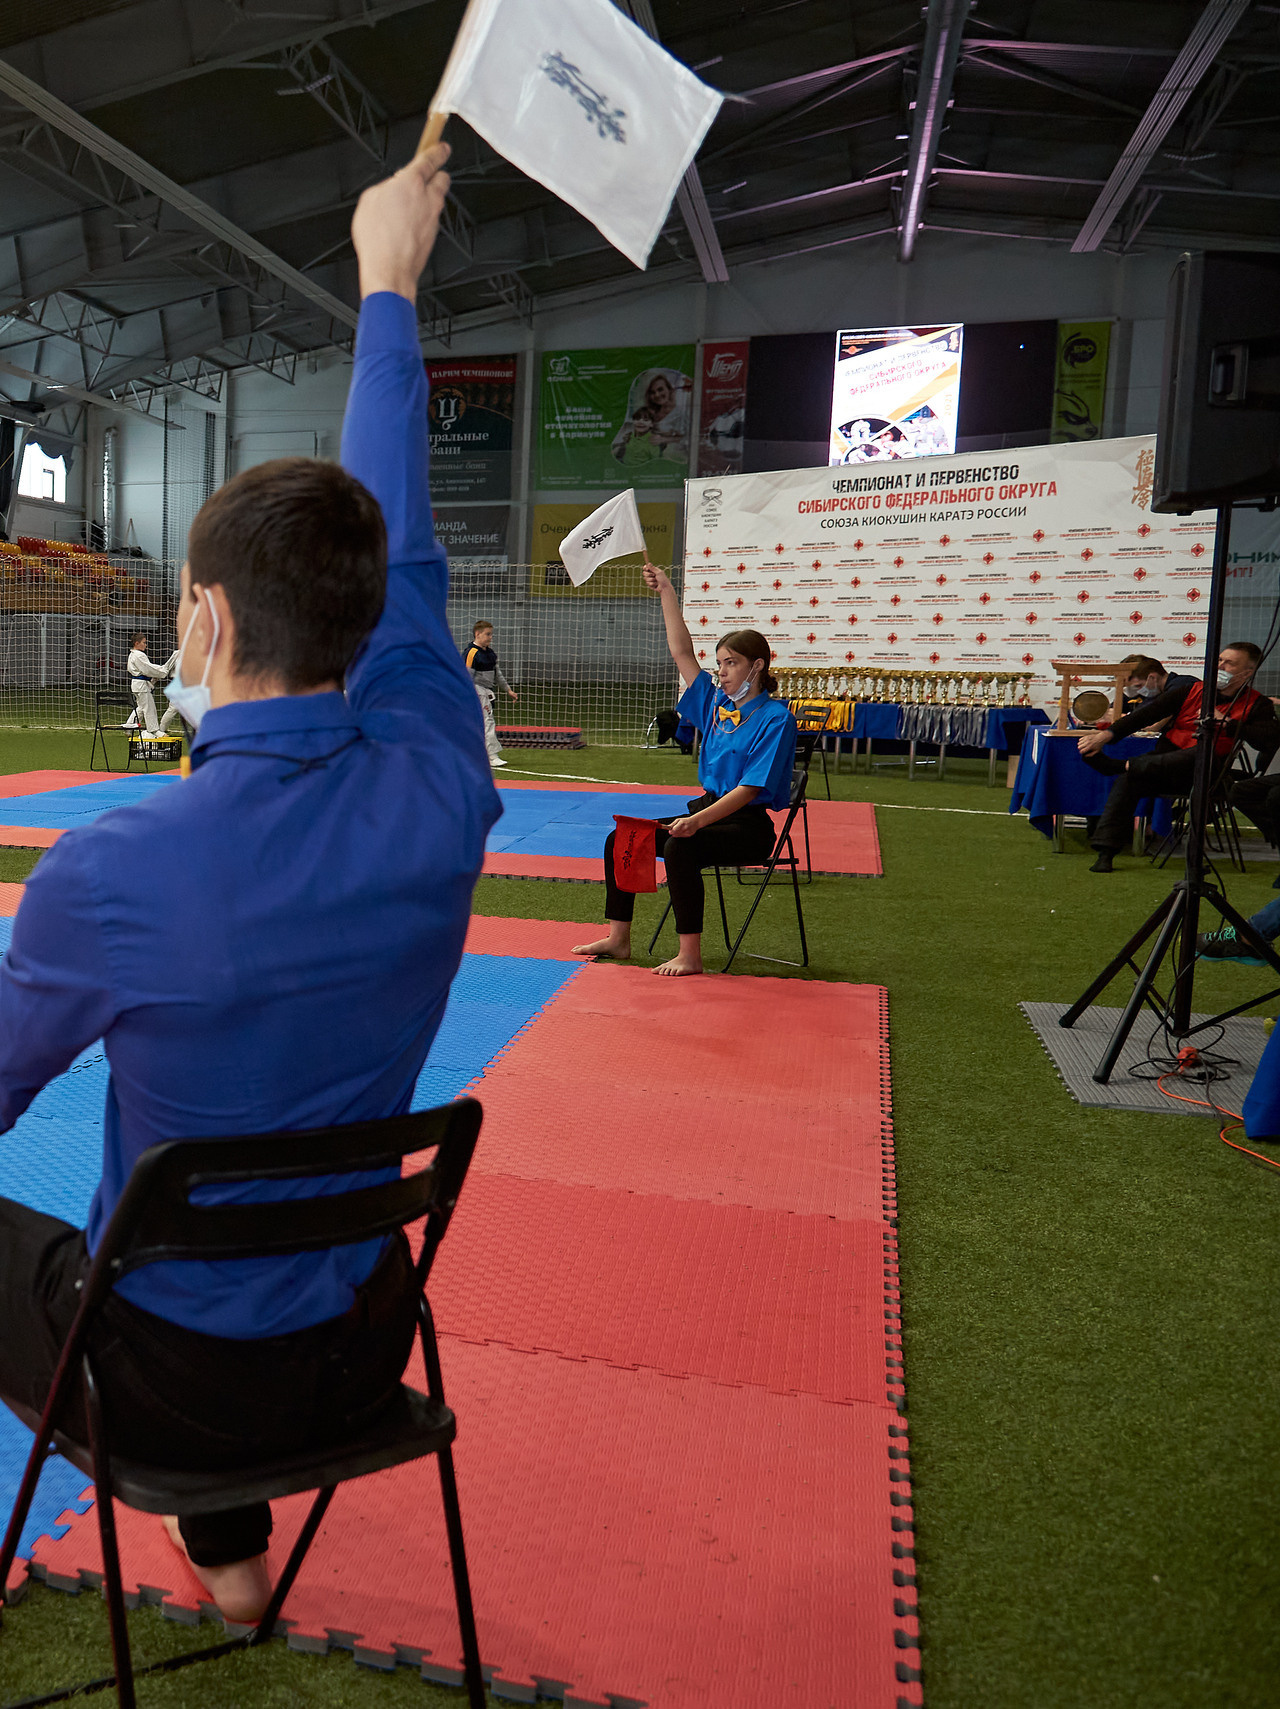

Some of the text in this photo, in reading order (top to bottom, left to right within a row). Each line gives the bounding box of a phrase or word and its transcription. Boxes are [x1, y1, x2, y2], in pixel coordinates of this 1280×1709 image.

[832, 464, 1020, 494] ЧЕМПИОНАТ И ПЕРВЕНСТВО
[797, 480, 1058, 514] СИБИРСКОГО ФЕДЕРАЛЬНОГО ОКРУГА
[820, 506, 1028, 529] СОЮЗА КИОКУШИН КАРАТЭ РОССИИ
[448, 533, 499, 545] ЗНАЧЕНИЕ
